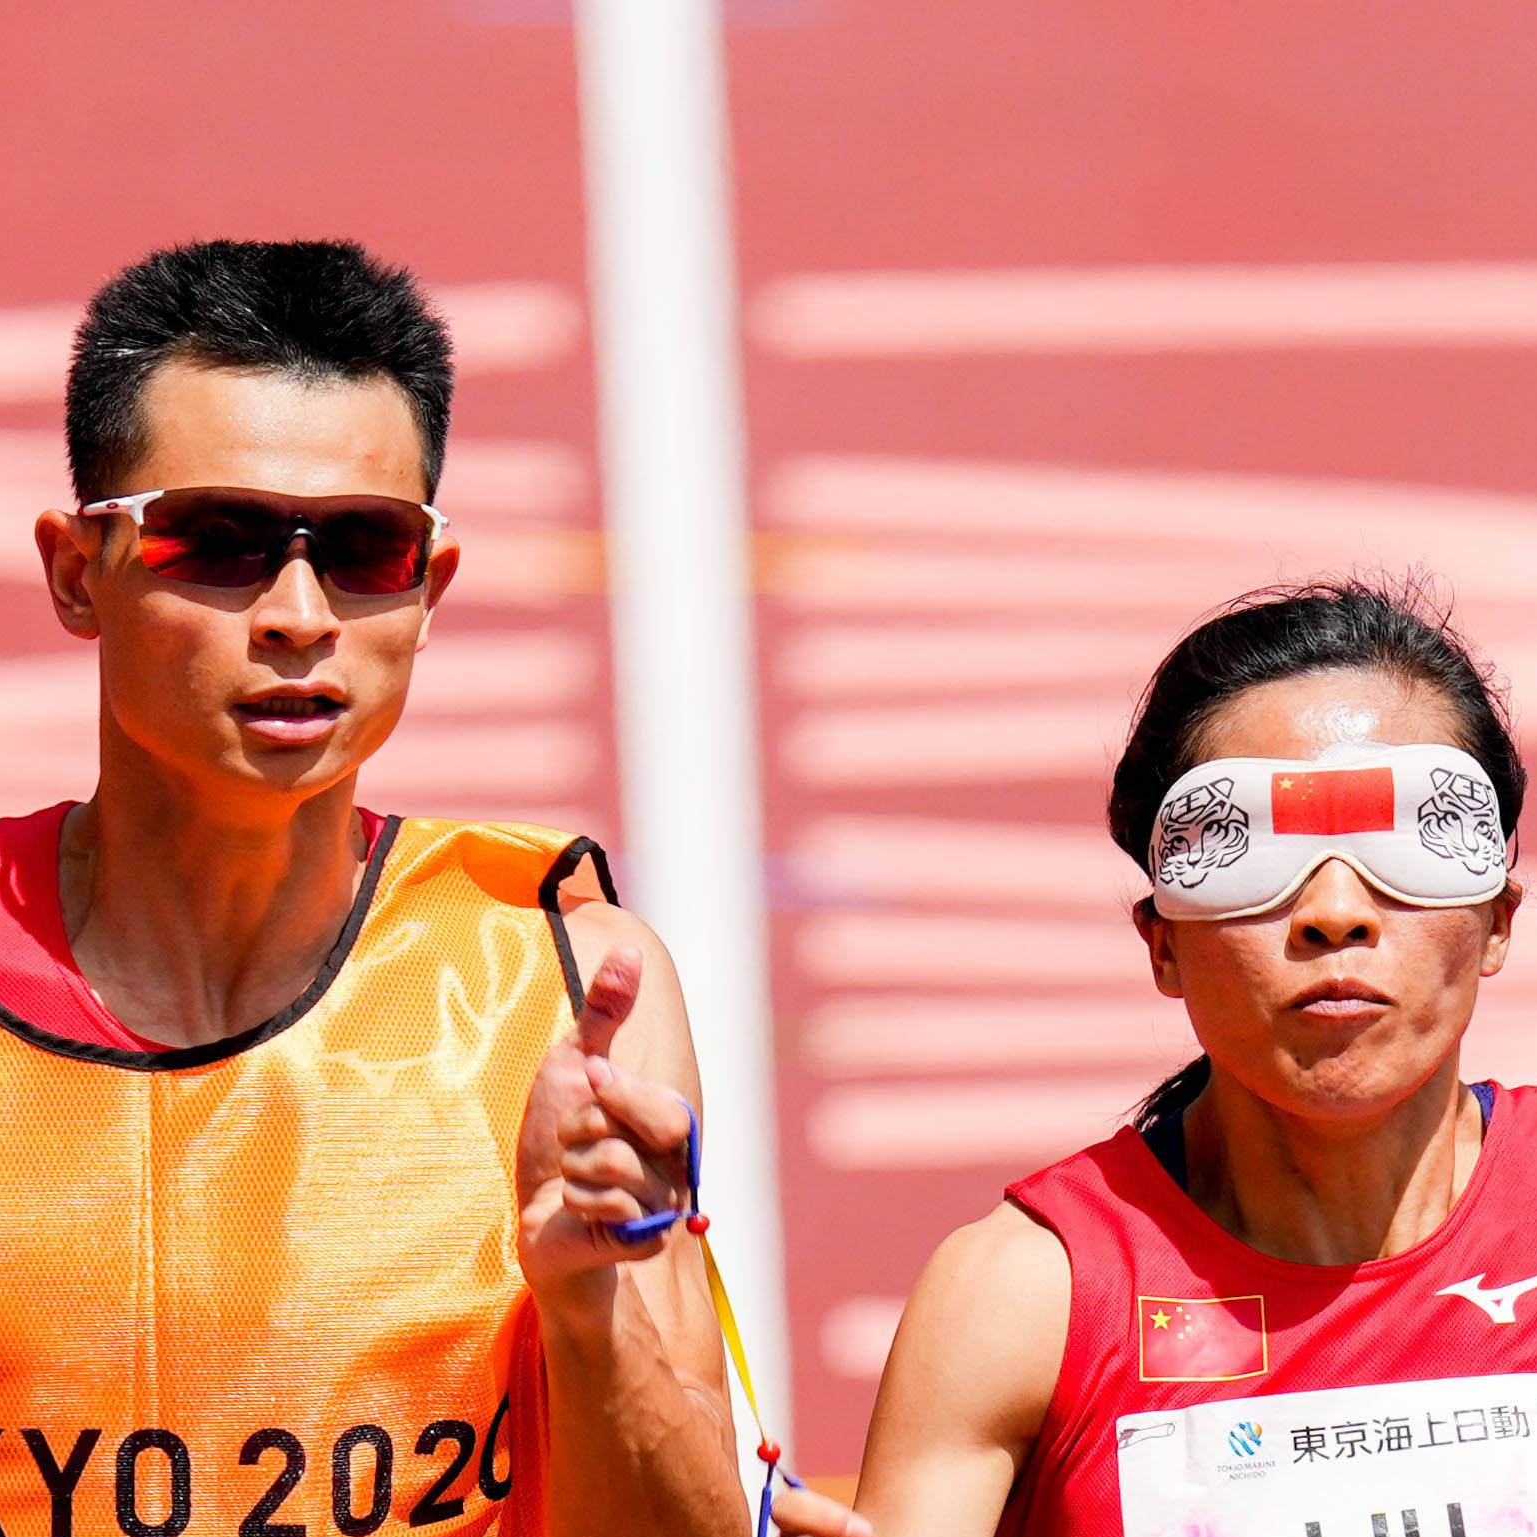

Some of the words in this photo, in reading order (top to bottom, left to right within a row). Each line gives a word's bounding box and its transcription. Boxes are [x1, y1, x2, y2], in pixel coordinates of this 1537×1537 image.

[1290, 1404, 1531, 1464] 東京海上日動
